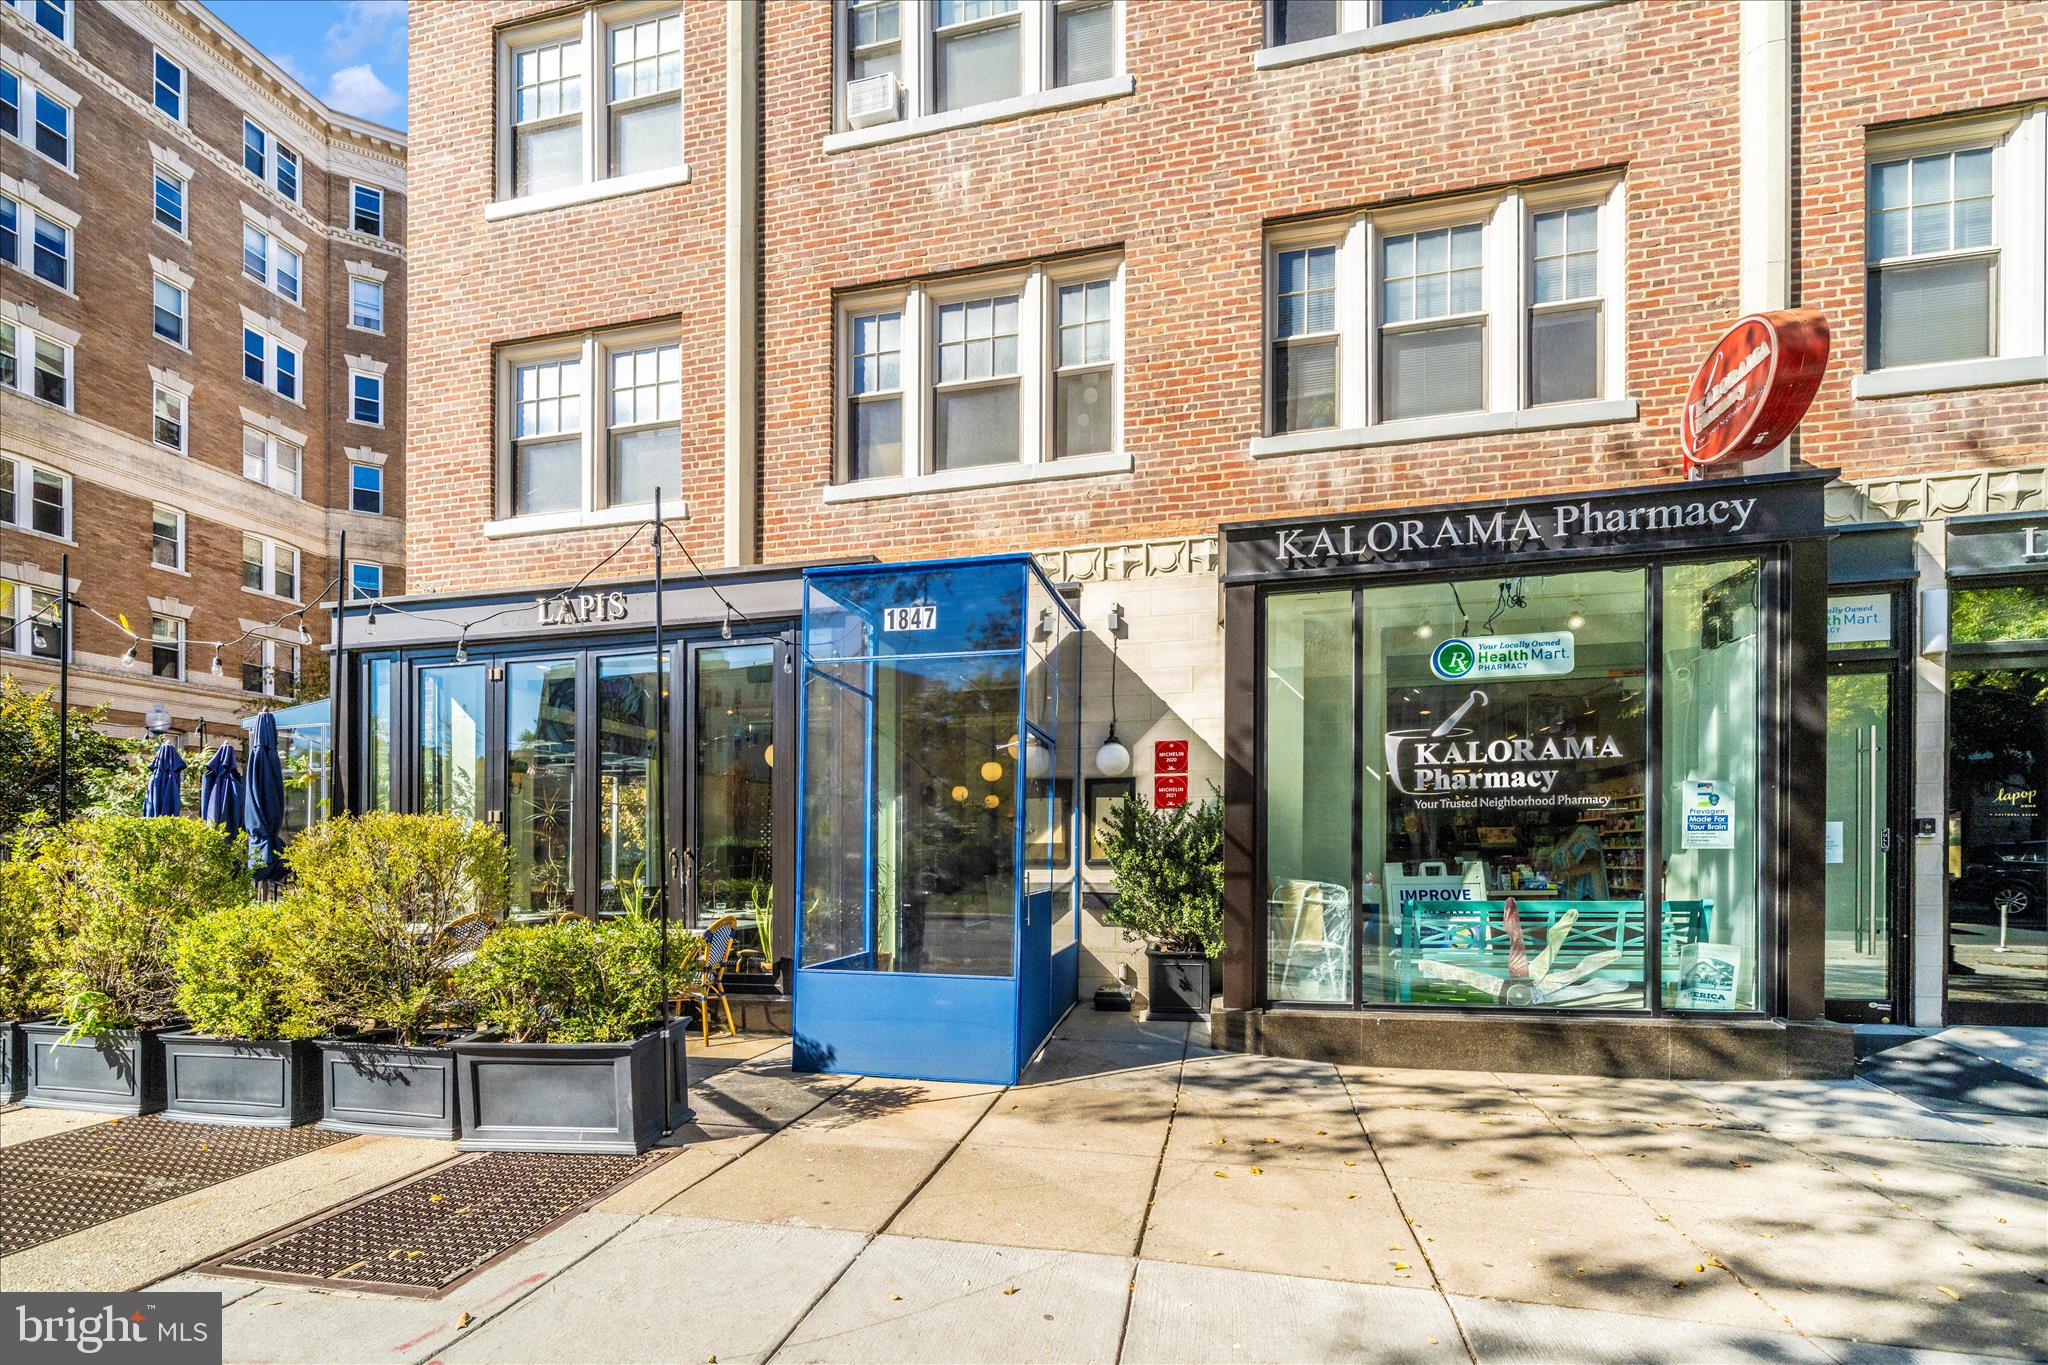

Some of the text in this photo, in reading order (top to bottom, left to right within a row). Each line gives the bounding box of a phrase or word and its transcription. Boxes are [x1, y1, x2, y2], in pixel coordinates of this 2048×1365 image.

[1276, 498, 1757, 560] KALORAMA Pharmacy
[536, 591, 624, 625] LAPIS
[1844, 605, 1873, 613] Owned
[887, 607, 935, 630] 1847
[1844, 613, 1878, 625] Mart
[1478, 639, 1561, 651] Your Locally Owned
[1478, 647, 1568, 663] Health Mart
[1478, 662, 1528, 672] PHARMACY
[1414, 735, 1623, 766] KALORAMA
[1414, 769, 1558, 793] Pharmacy
[1414, 795, 1611, 810] Your Trusted Neighborhood Pharmacy
[1400, 889, 1471, 901] IMPROVE
[1688, 991, 1726, 1001] ERICA
